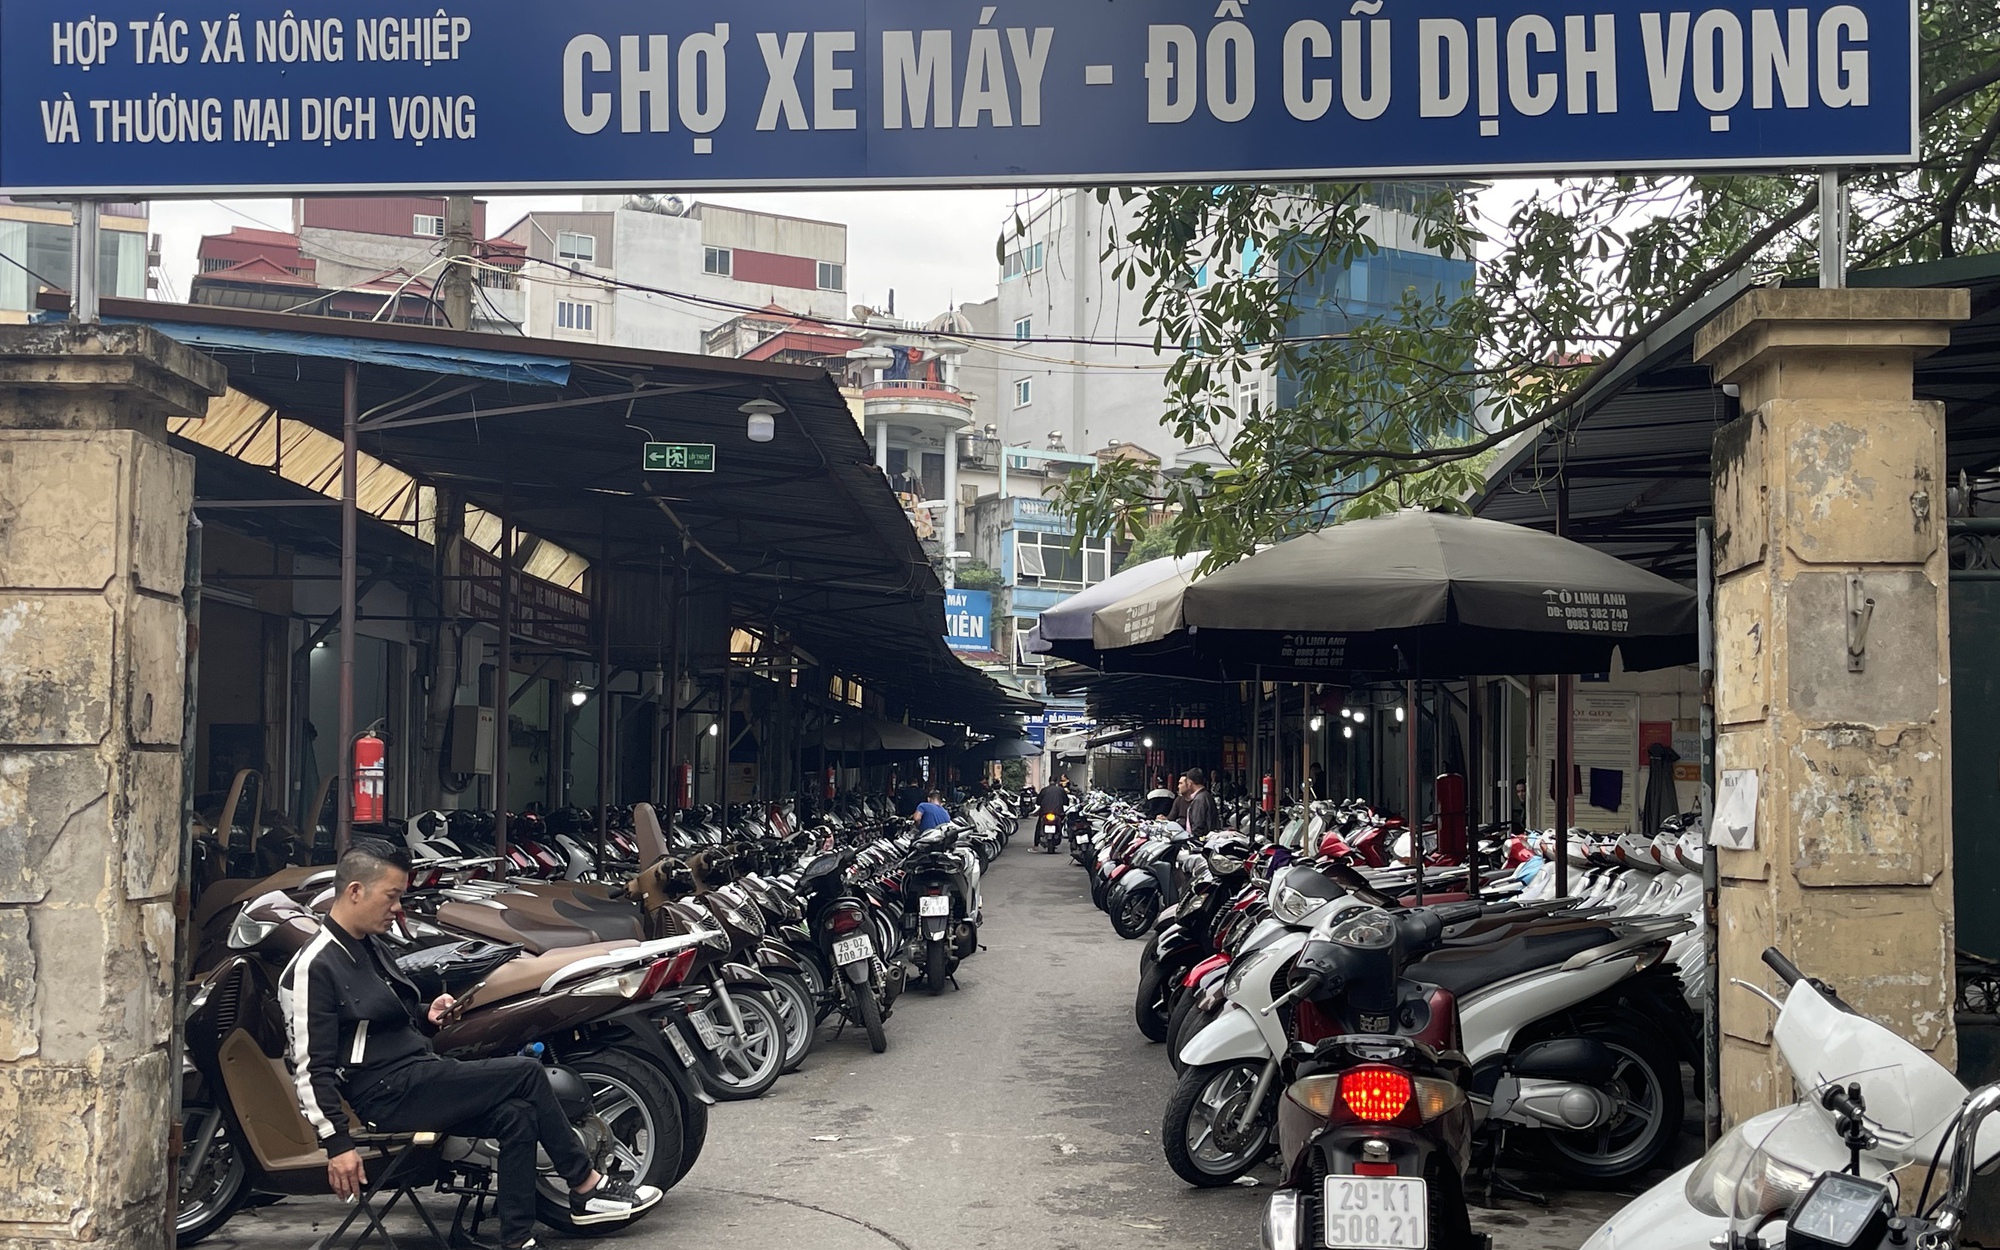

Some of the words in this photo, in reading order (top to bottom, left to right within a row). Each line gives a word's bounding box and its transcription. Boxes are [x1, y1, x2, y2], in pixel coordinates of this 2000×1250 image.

[52, 14, 118, 72] HỢP
[129, 13, 189, 64] TÁC
[200, 13, 245, 63] XÃ
[255, 9, 343, 63] NÔNG
[356, 8, 471, 68] NGHIỆP
[563, 22, 729, 154] CHỢ
[755, 30, 857, 131] XE
[882, 6, 1054, 130] MÁY
[1085, 65, 1113, 85] -
[1144, 0, 1256, 125] ĐỒ
[1283, 0, 1391, 120] CŨ
[1420, 14, 1617, 136] DỊCH
[1640, 5, 1869, 132] VỌNG
[41, 92, 80, 144] VÀ
[90, 92, 223, 143] THƯƠNG
[233, 97, 290, 148] MẠI
[302, 96, 376, 147] DỊCH
[389, 94, 476, 147] VỌNG
[947, 593, 967, 607] MÁY
[1574, 592, 1600, 605] LINH
[1603, 594, 1627, 606] ANH
[1610, 609, 1629, 620] 748
[1566, 619, 1590, 631] 0983
[1592, 620, 1610, 631] 403
[1611, 621, 1629, 632] 697
[1306, 636, 1327, 646] LINH
[1327, 637, 1347, 646] ANH
[1588, 709, 1613, 717] QUY
[1340, 1182, 1409, 1212] 29-K1
[1332, 1215, 1418, 1245] 508.21
